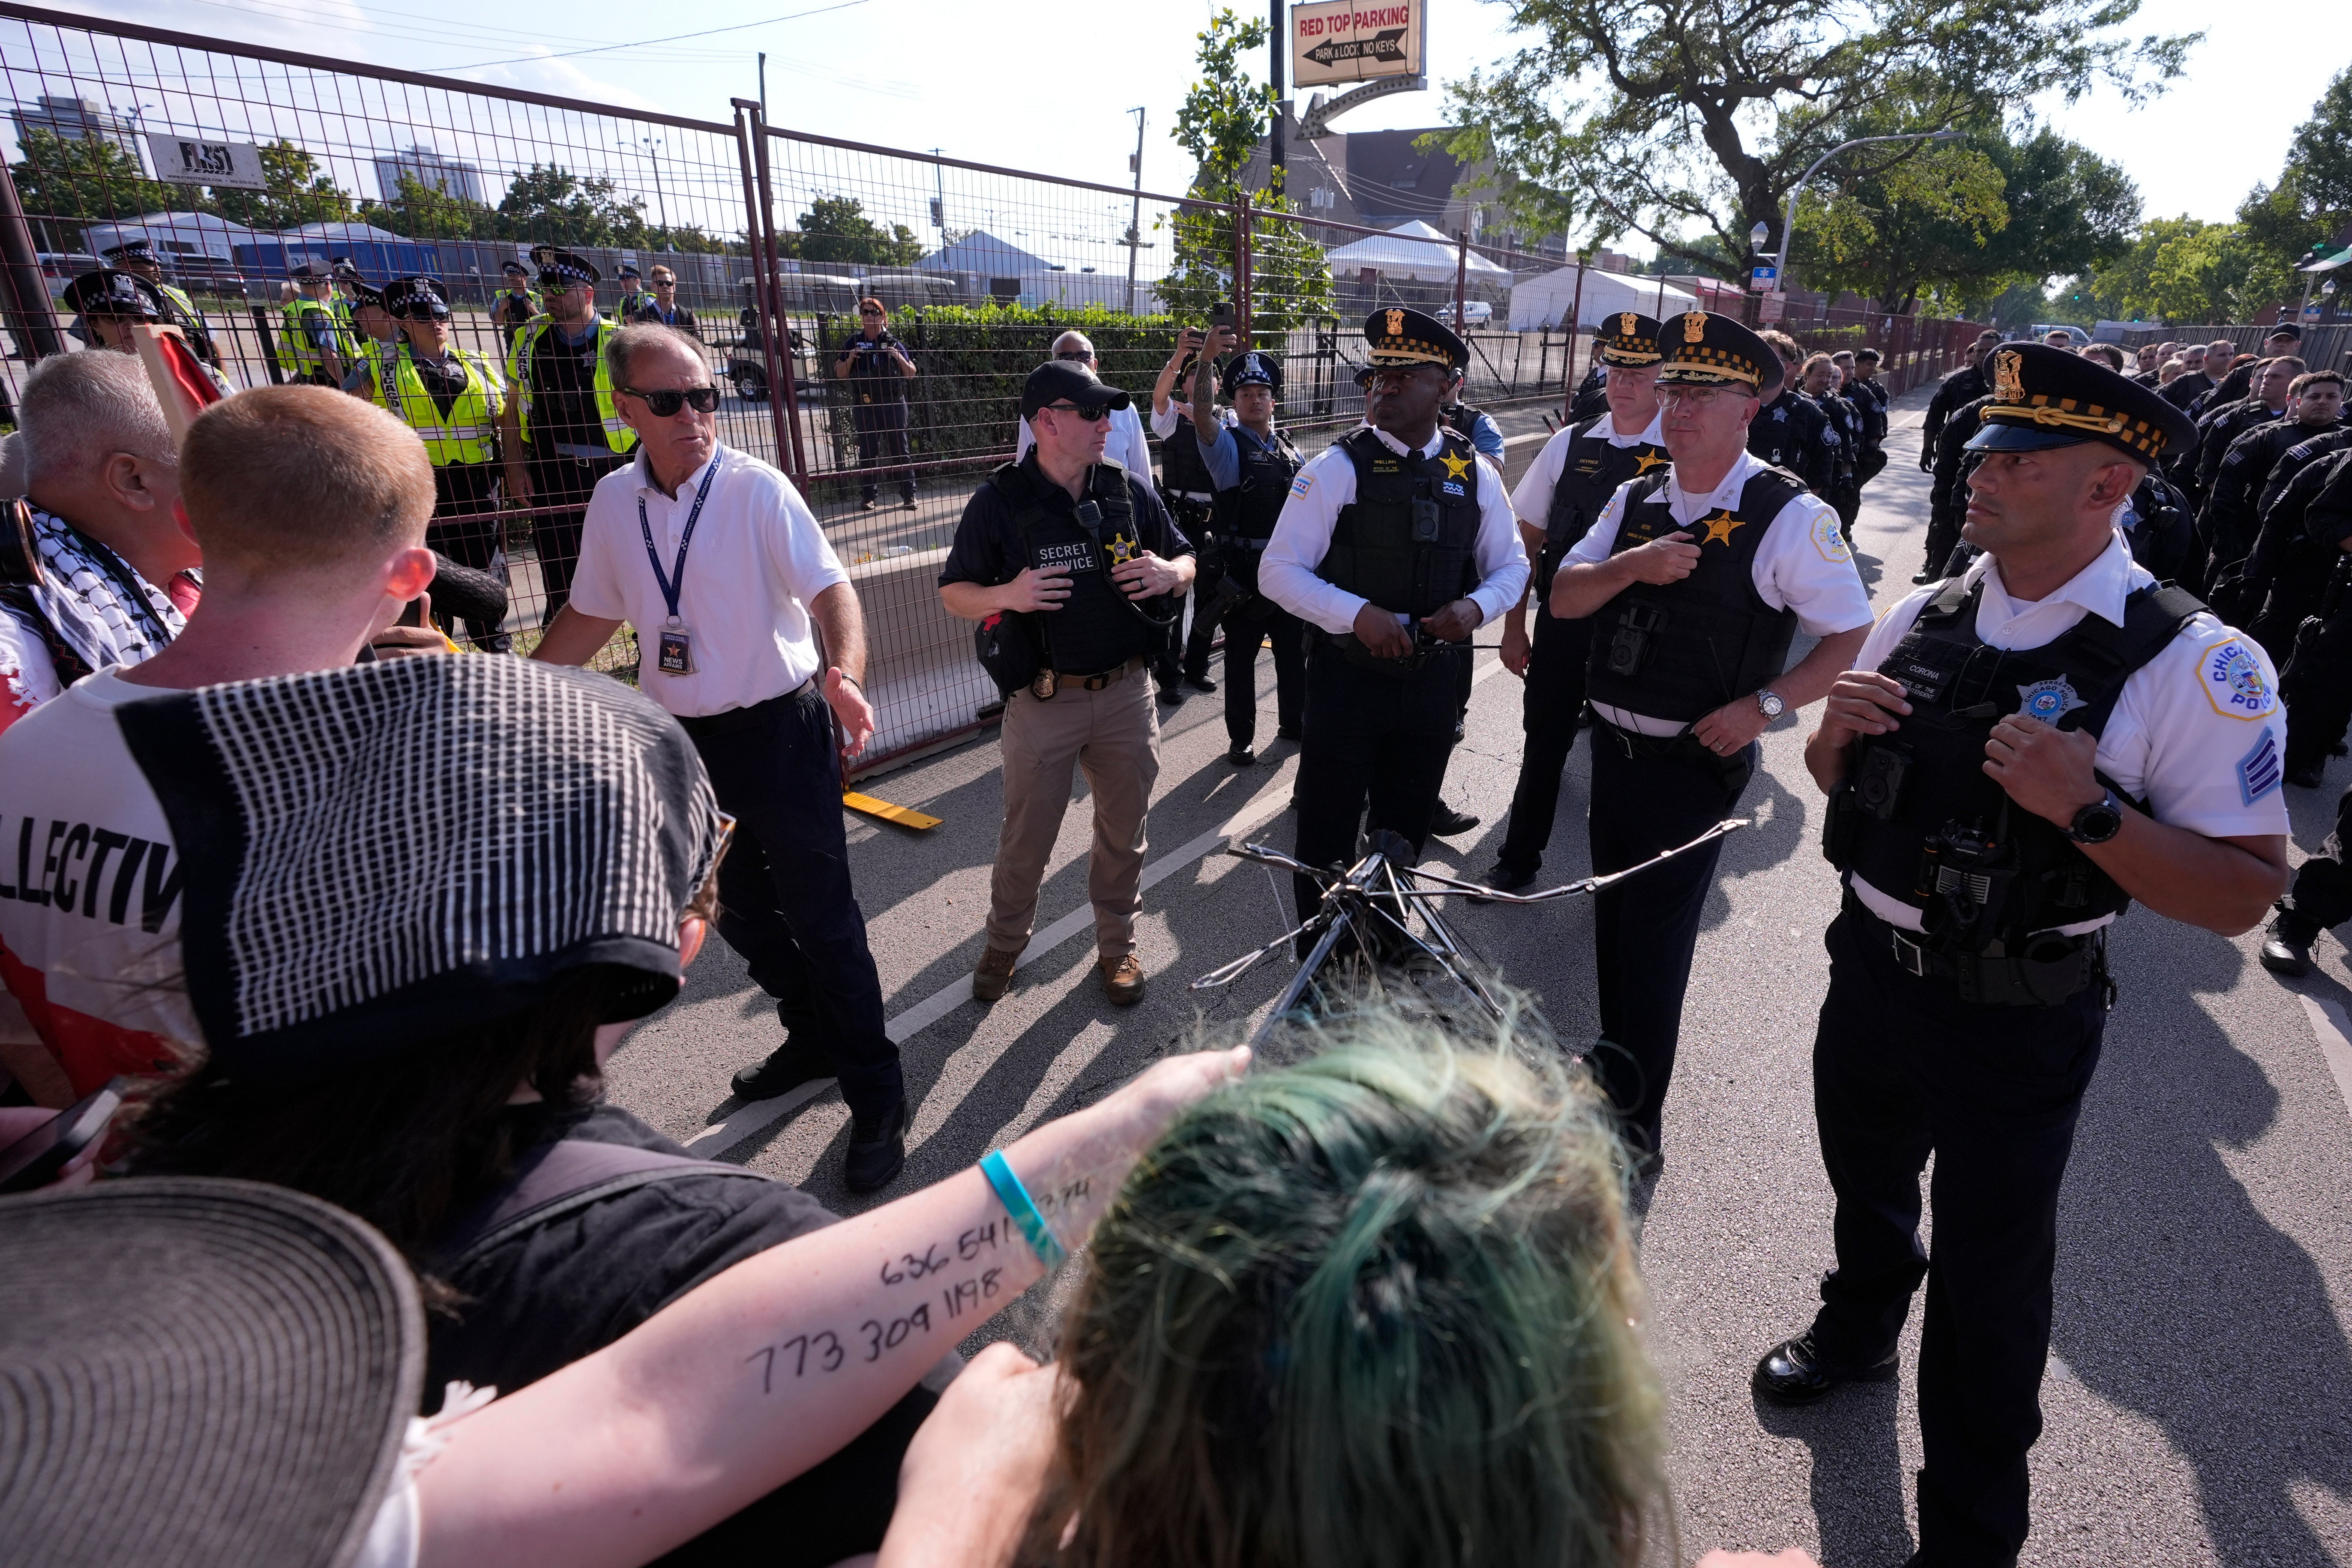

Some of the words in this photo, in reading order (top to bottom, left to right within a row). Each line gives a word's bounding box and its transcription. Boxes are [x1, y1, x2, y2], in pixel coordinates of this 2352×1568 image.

[1300, 18, 1324, 37] RED
[1327, 14, 1351, 33] TOP
[1354, 6, 1408, 30] PARKING
[1315, 47, 1333, 60] PARK
[1334, 50, 1339, 58] &
[1339, 43, 1360, 57] LOCK
[1363, 41, 1374, 54] NO
[1375, 39, 1395, 53] KEYS
[185, 168, 234, 176] FENCE
[517, 333, 535, 380] CHICAGO
[383, 362, 400, 407] CHICAGO
[700, 480, 709, 497] CHICAGO
[706, 468, 716, 483] POLICE
[685, 521, 694, 539] CHICAGO
[690, 508, 698, 524] POLICE
[1640, 523, 1652, 531] HEIN
[1039, 542, 1087, 560] SECRET
[664, 656, 683, 665] NEWS
[1909, 665, 1939, 680] CORONA
[2213, 645, 2259, 682] CHICAGO
[1896, 677, 1914, 686] OFFICE
[2039, 680, 2073, 693] SERGEANT
[2024, 685, 2057, 703] CHICAGO
[2058, 689, 2069, 712] POLICE
[1955, 847, 1982, 856] MOTOROL
[880, 1243, 950, 1286] 636
[958, 1216, 1010, 1261] 541
[744, 1330, 845, 1395] 773
[860, 1302, 930, 1362] 309
[944, 1266, 1004, 1320] 1198
